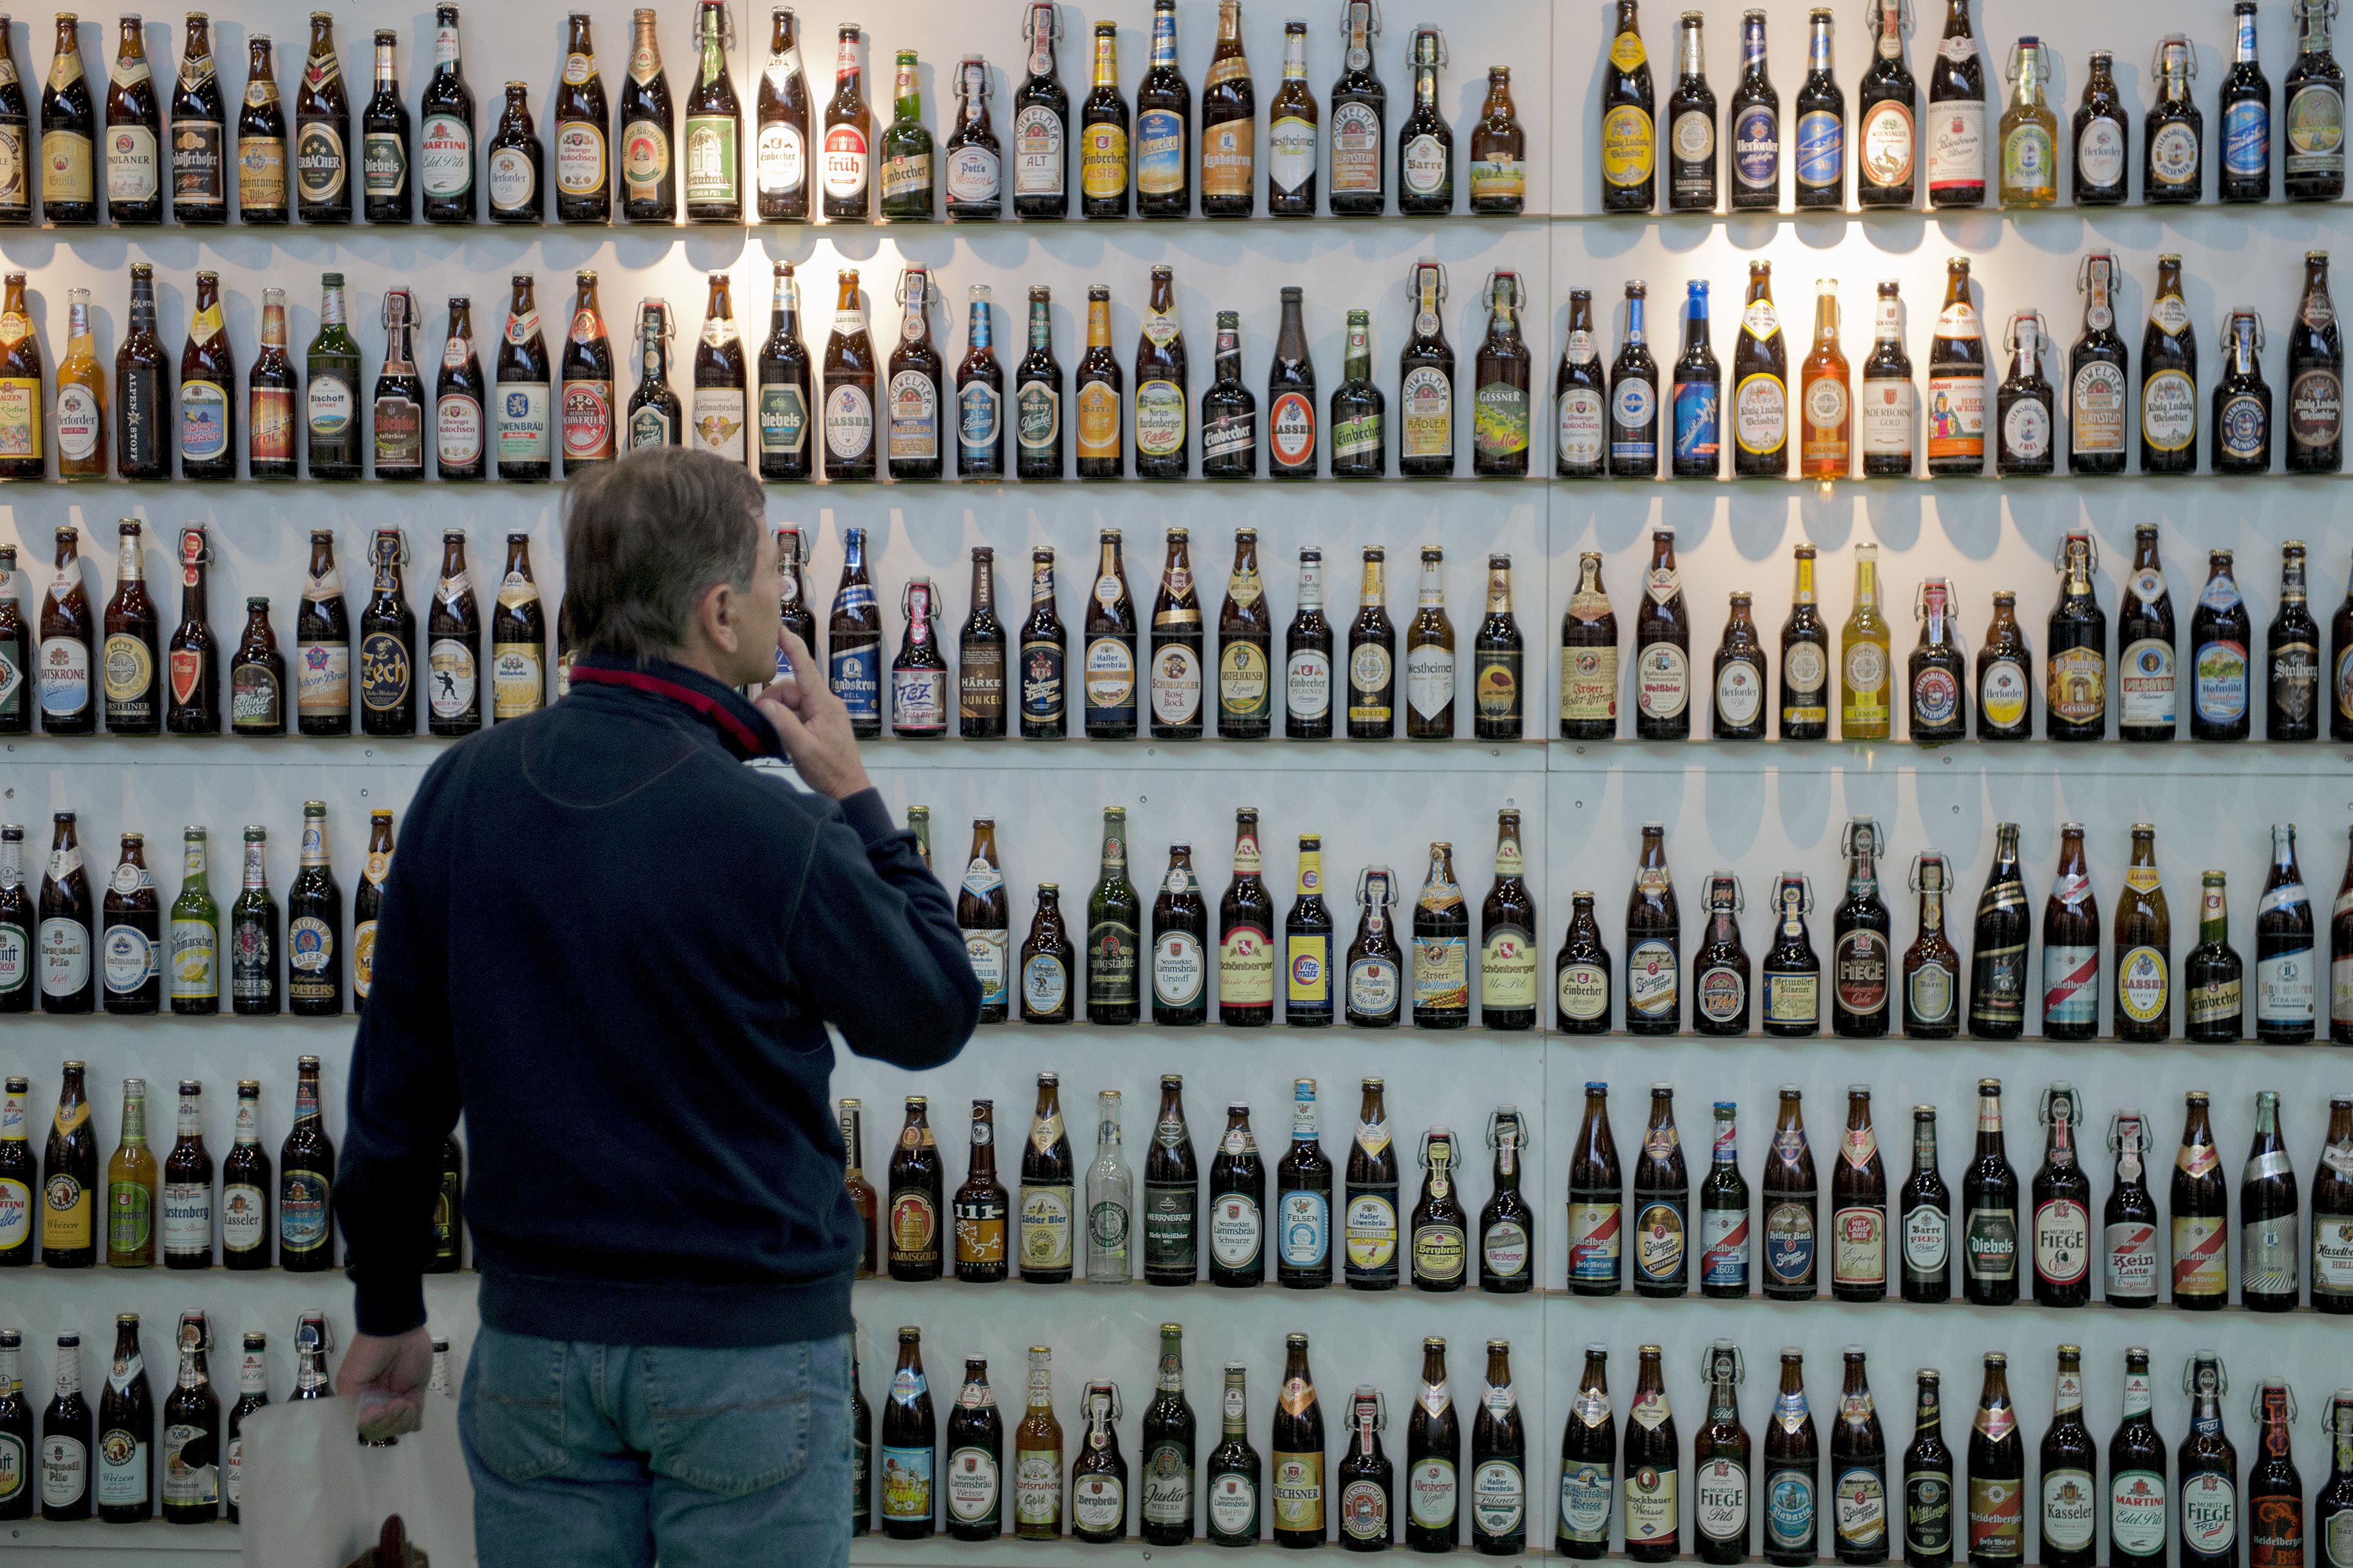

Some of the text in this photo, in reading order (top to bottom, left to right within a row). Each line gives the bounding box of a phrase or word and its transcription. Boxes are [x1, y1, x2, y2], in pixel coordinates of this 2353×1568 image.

[1018, 110, 1058, 141] SCHWELMER
[1334, 107, 1376, 138] SCHWELMER
[423, 141, 465, 151] MARTINI
[1270, 136, 1313, 148] Westheimer
[2084, 146, 2121, 156] Herforder
[108, 156, 149, 165] PAULANER
[298, 155, 340, 168] ERBACHER
[441, 154, 464, 169] Pils
[828, 154, 859, 174] früh
[1027, 156, 1046, 167] ALT
[1335, 153, 1374, 164] BERNSTEIN
[365, 159, 399, 173] Diebels
[1408, 159, 1442, 170] Barre
[492, 172, 526, 183] Herforder
[1087, 168, 1119, 179] ALSTER
[1406, 372, 1447, 402] SCHWELMER
[2078, 367, 2122, 397] SCHWELMER
[891, 376, 931, 405] SCHWELMER
[1479, 390, 1520, 402] GESSNER
[311, 394, 344, 403] Bischoff
[569, 395, 592, 405] RED
[695, 401, 741, 413] Weihnachtsbier
[1149, 408, 1171, 417] Norten-
[58, 415, 95, 426] Herforder
[498, 419, 543, 431] LÖWENBRÄU
[761, 413, 800, 427] Diebels
[828, 417, 869, 427] LASSER
[1021, 414, 1051, 431] Dunkel
[1140, 417, 1180, 430] Hardenberger
[1408, 419, 1446, 428] RADLER
[1880, 418, 1900, 426] GOLD
[892, 424, 931, 434] WEIZEN
[1272, 425, 1312, 434] LASSER
[634, 431, 661, 448] Dunkel
[1143, 429, 1174, 444] Radler
[2231, 437, 2259, 449] DUNKEL
[1090, 661, 1126, 669] Löwenbräu
[1408, 663, 1452, 674] Westheimer
[41, 669, 85, 680] RATSKRONE
[961, 677, 1000, 687] HÄRKE
[1645, 683, 1680, 692] Weißbier
[2204, 682, 2242, 692] Hofmühl
[1722, 687, 1758, 697] Herforder
[1987, 688, 2023, 699] Herforder
[233, 695, 273, 709] Berliner
[963, 695, 1000, 705] DUNKEL
[234, 707, 268, 719] Weisse
[2061, 704, 2095, 713] GESSNER
[289, 919, 330, 944] OKTOBER
[49, 957, 70, 967] Pils
[106, 955, 141, 966] Gutmann
[295, 954, 323, 964] BIER
[1157, 964, 1198, 973] Lammsbräu
[1299, 962, 1319, 971] Vita-
[1841, 962, 1884, 980] FIEGE
[1297, 968, 1318, 978] malz
[2122, 978, 2166, 988] LASSER
[1708, 994, 1737, 1009] 1744
[224, 1214, 259, 1225] Kasseler
[1048, 1214, 1066, 1223] Bier
[1148, 1212, 1190, 1221] HERRNBRÄU
[1214, 1227, 1255, 1235] Lammsbräu
[1912, 1225, 1940, 1234] Barre
[1218, 1236, 1250, 1245] Schwarze
[1792, 1231, 1811, 1240] Bock
[1910, 1235, 1943, 1244] FREY
[2041, 1230, 2084, 1248] FIEGE
[1418, 1244, 1460, 1254] Bergbräu
[1972, 1237, 2013, 1253] Diebels
[890, 1251, 937, 1261] LAMMSGOLD
[1843, 1248, 1875, 1263] Export
[2113, 1254, 2154, 1267] Kein
[1715, 1265, 1734, 1275] 1603
[2118, 1266, 2148, 1275] Latte
[2116, 1278, 2147, 1289] Original
[1714, 1408, 1733, 1419] Pils
[2197, 1420, 2218, 1430] FREI
[49, 1472, 68, 1482] Pils
[102, 1473, 134, 1483] Weizen
[951, 1480, 992, 1488] Lammsbräu
[1415, 1479, 1453, 1492] Allersheimer
[1274, 1487, 1318, 1498] OECHSNER
[1345, 1484, 1382, 1506] FLENSBURGER
[1701, 1489, 1742, 1505] FIEGE
[1025, 1495, 1046, 1506] Gold
[1079, 1495, 1117, 1506] Bergbräu
[1481, 1496, 1515, 1505] Pilsner
[1626, 1494, 1671, 1505] Stockbauer
[2116, 1495, 2163, 1506] MARTINI
[1633, 1503, 1664, 1516] Weisse
[2047, 1505, 2091, 1519] Kasseler
[2188, 1503, 2231, 1522] FIEGE
[1708, 1509, 1733, 1522] Pils
[2115, 1509, 2161, 1526] Edel Pils
[1347, 1516, 1382, 1533] KELLERBIER
[2194, 1522, 2218, 1531] FREI
